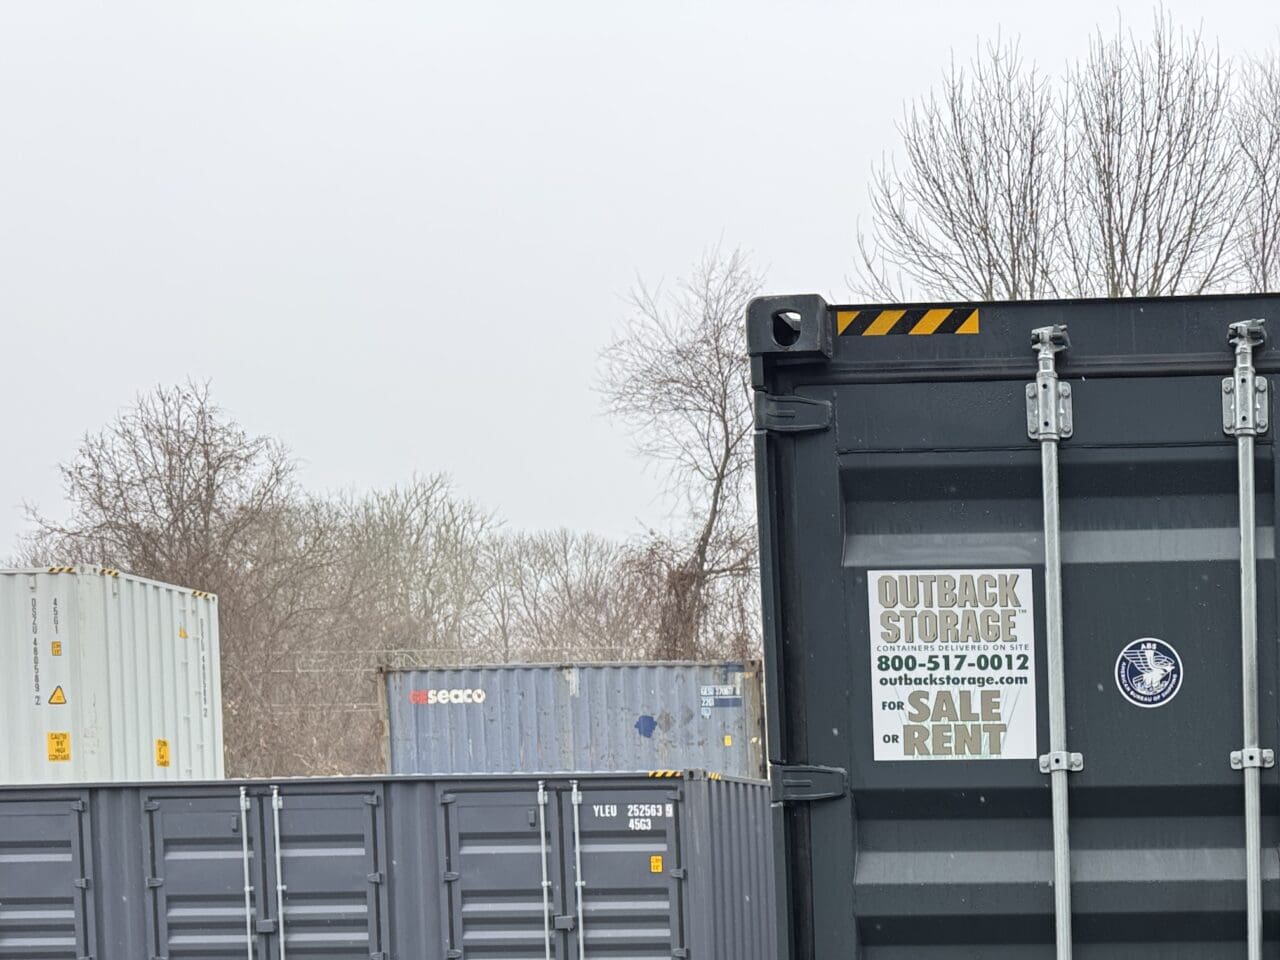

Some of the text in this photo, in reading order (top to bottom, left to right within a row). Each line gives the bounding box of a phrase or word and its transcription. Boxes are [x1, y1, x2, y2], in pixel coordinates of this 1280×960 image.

[877, 574, 1022, 608] OUTBACK
[880, 609, 1018, 643] STORAGE
[876, 643, 1030, 652] CONTAINERS DELIVERED ON SITE
[877, 654, 1030, 672] 800-517-0012
[879, 674, 1029, 687] outbackstorage.com
[881, 690, 1002, 722] FOR SALE
[882, 724, 1007, 756] OR RENT
[593, 804, 617, 817] YLEU
[627, 804, 663, 817] 252563
[628, 818, 652, 831] 45G3
